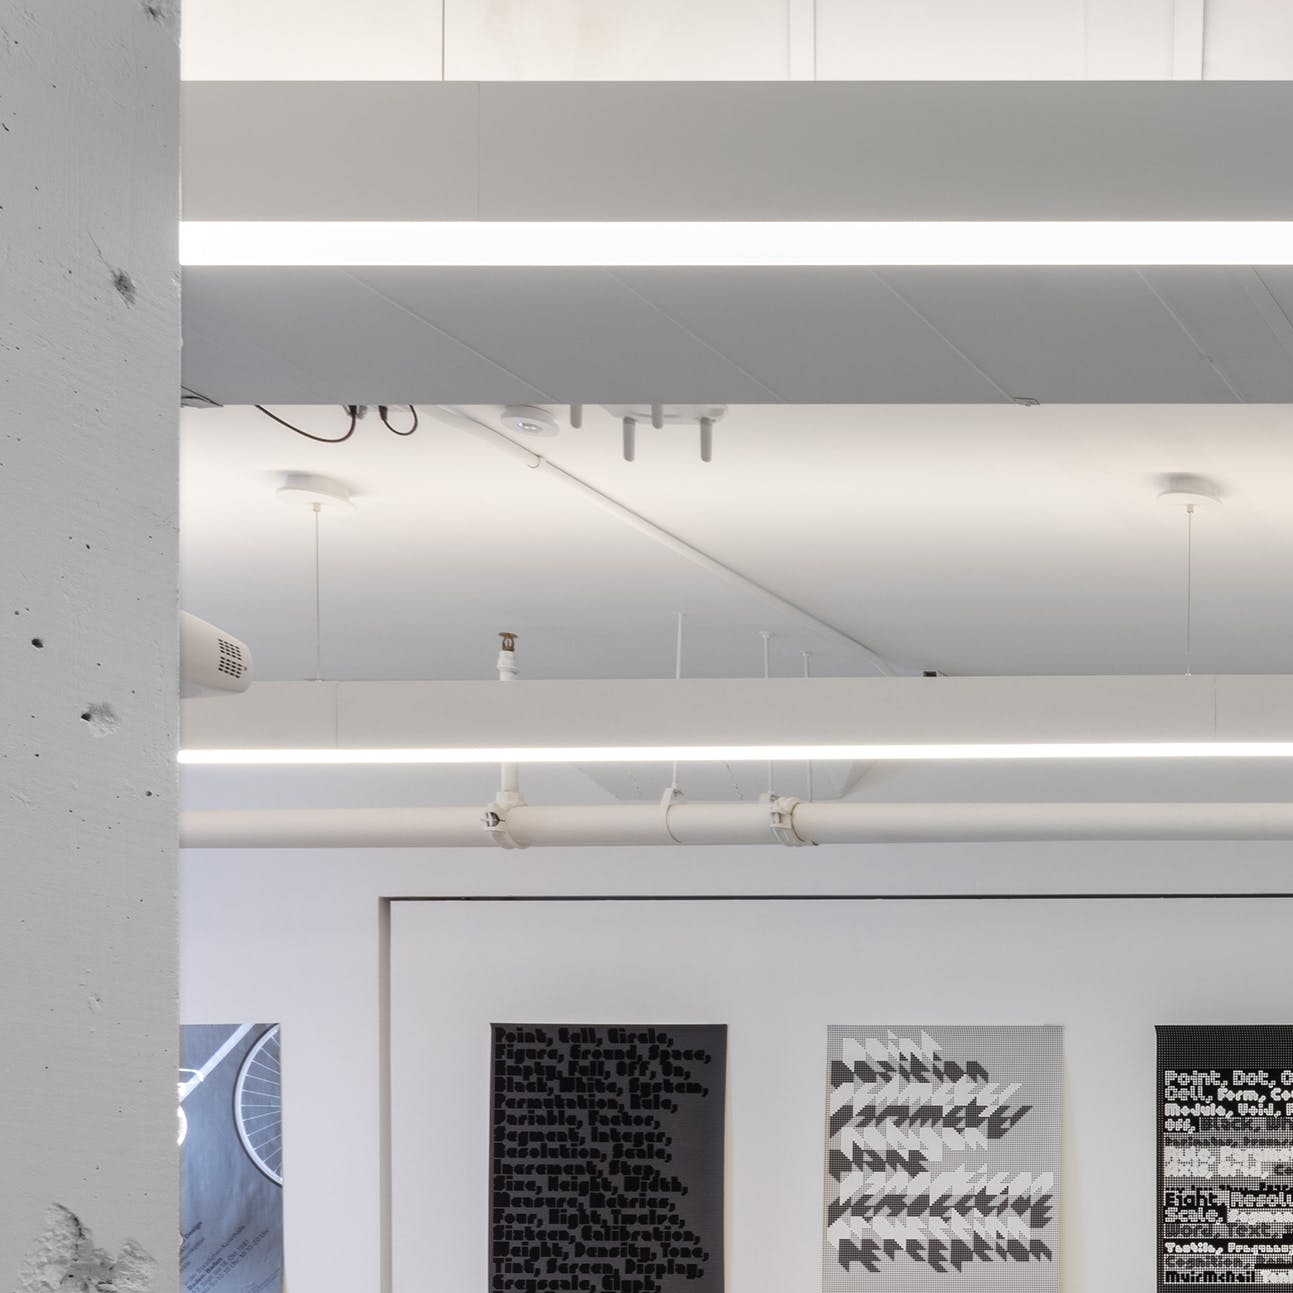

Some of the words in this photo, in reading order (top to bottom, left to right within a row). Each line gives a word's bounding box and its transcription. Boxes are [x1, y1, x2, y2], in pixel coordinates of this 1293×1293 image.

[495, 1028, 552, 1046] Point,
[558, 1028, 602, 1046] Cell,
[608, 1028, 673, 1046] Circle,
[495, 1044, 564, 1064] Figure,
[570, 1044, 643, 1064] Ground,
[649, 1044, 711, 1064] Space,
[568, 1061, 610, 1080] Full,
[617, 1061, 655, 1080] Off,
[662, 1061, 690, 1080] On,
[1165, 1070, 1228, 1088] Point,
[1233, 1070, 1276, 1088] Dot,
[494, 1077, 554, 1096] Black,
[559, 1077, 623, 1096] White,
[629, 1077, 708, 1096] System,
[1165, 1086, 1213, 1103] Cell,
[1218, 1086, 1266, 1103] Form,
[494, 1094, 624, 1113] Permutation,
[631, 1094, 678, 1113] Rule,
[1165, 1103, 1233, 1118] Module,
[1238, 1103, 1281, 1118] Void,
[494, 1110, 582, 1128] Variable,
[588, 1110, 660, 1128] Factor,
[1165, 1118, 1195, 1133] Off,
[1200, 1118, 1261, 1133] Black,
[494, 1126, 585, 1146] Segment,
[592, 1126, 672, 1146] Integer,
[494, 1143, 607, 1162] Resolution,
[613, 1143, 672, 1162] Scale,
[494, 1159, 602, 1179] Increment,
[609, 1159, 660, 1179] Step,
[494, 1176, 542, 1196] Size,
[548, 1176, 618, 1196] Height,
[624, 1176, 688, 1196] Width,
[494, 1192, 583, 1211] Measure,
[590, 1192, 675, 1211] Metrics,
[494, 1209, 543, 1229] Four,
[549, 1209, 608, 1229] Eight,
[612, 1209, 685, 1229] Twelve,
[494, 1225, 575, 1245] Sixteen,
[581, 1225, 700, 1245] Calibration,
[494, 1242, 569, 1262] Weight,
[575, 1242, 656, 1262] Density,
[661, 1242, 709, 1262] Tone,
[494, 1258, 541, 1279] Tint,
[547, 1258, 619, 1279] Screen,
[625, 1258, 704, 1279] Display,
